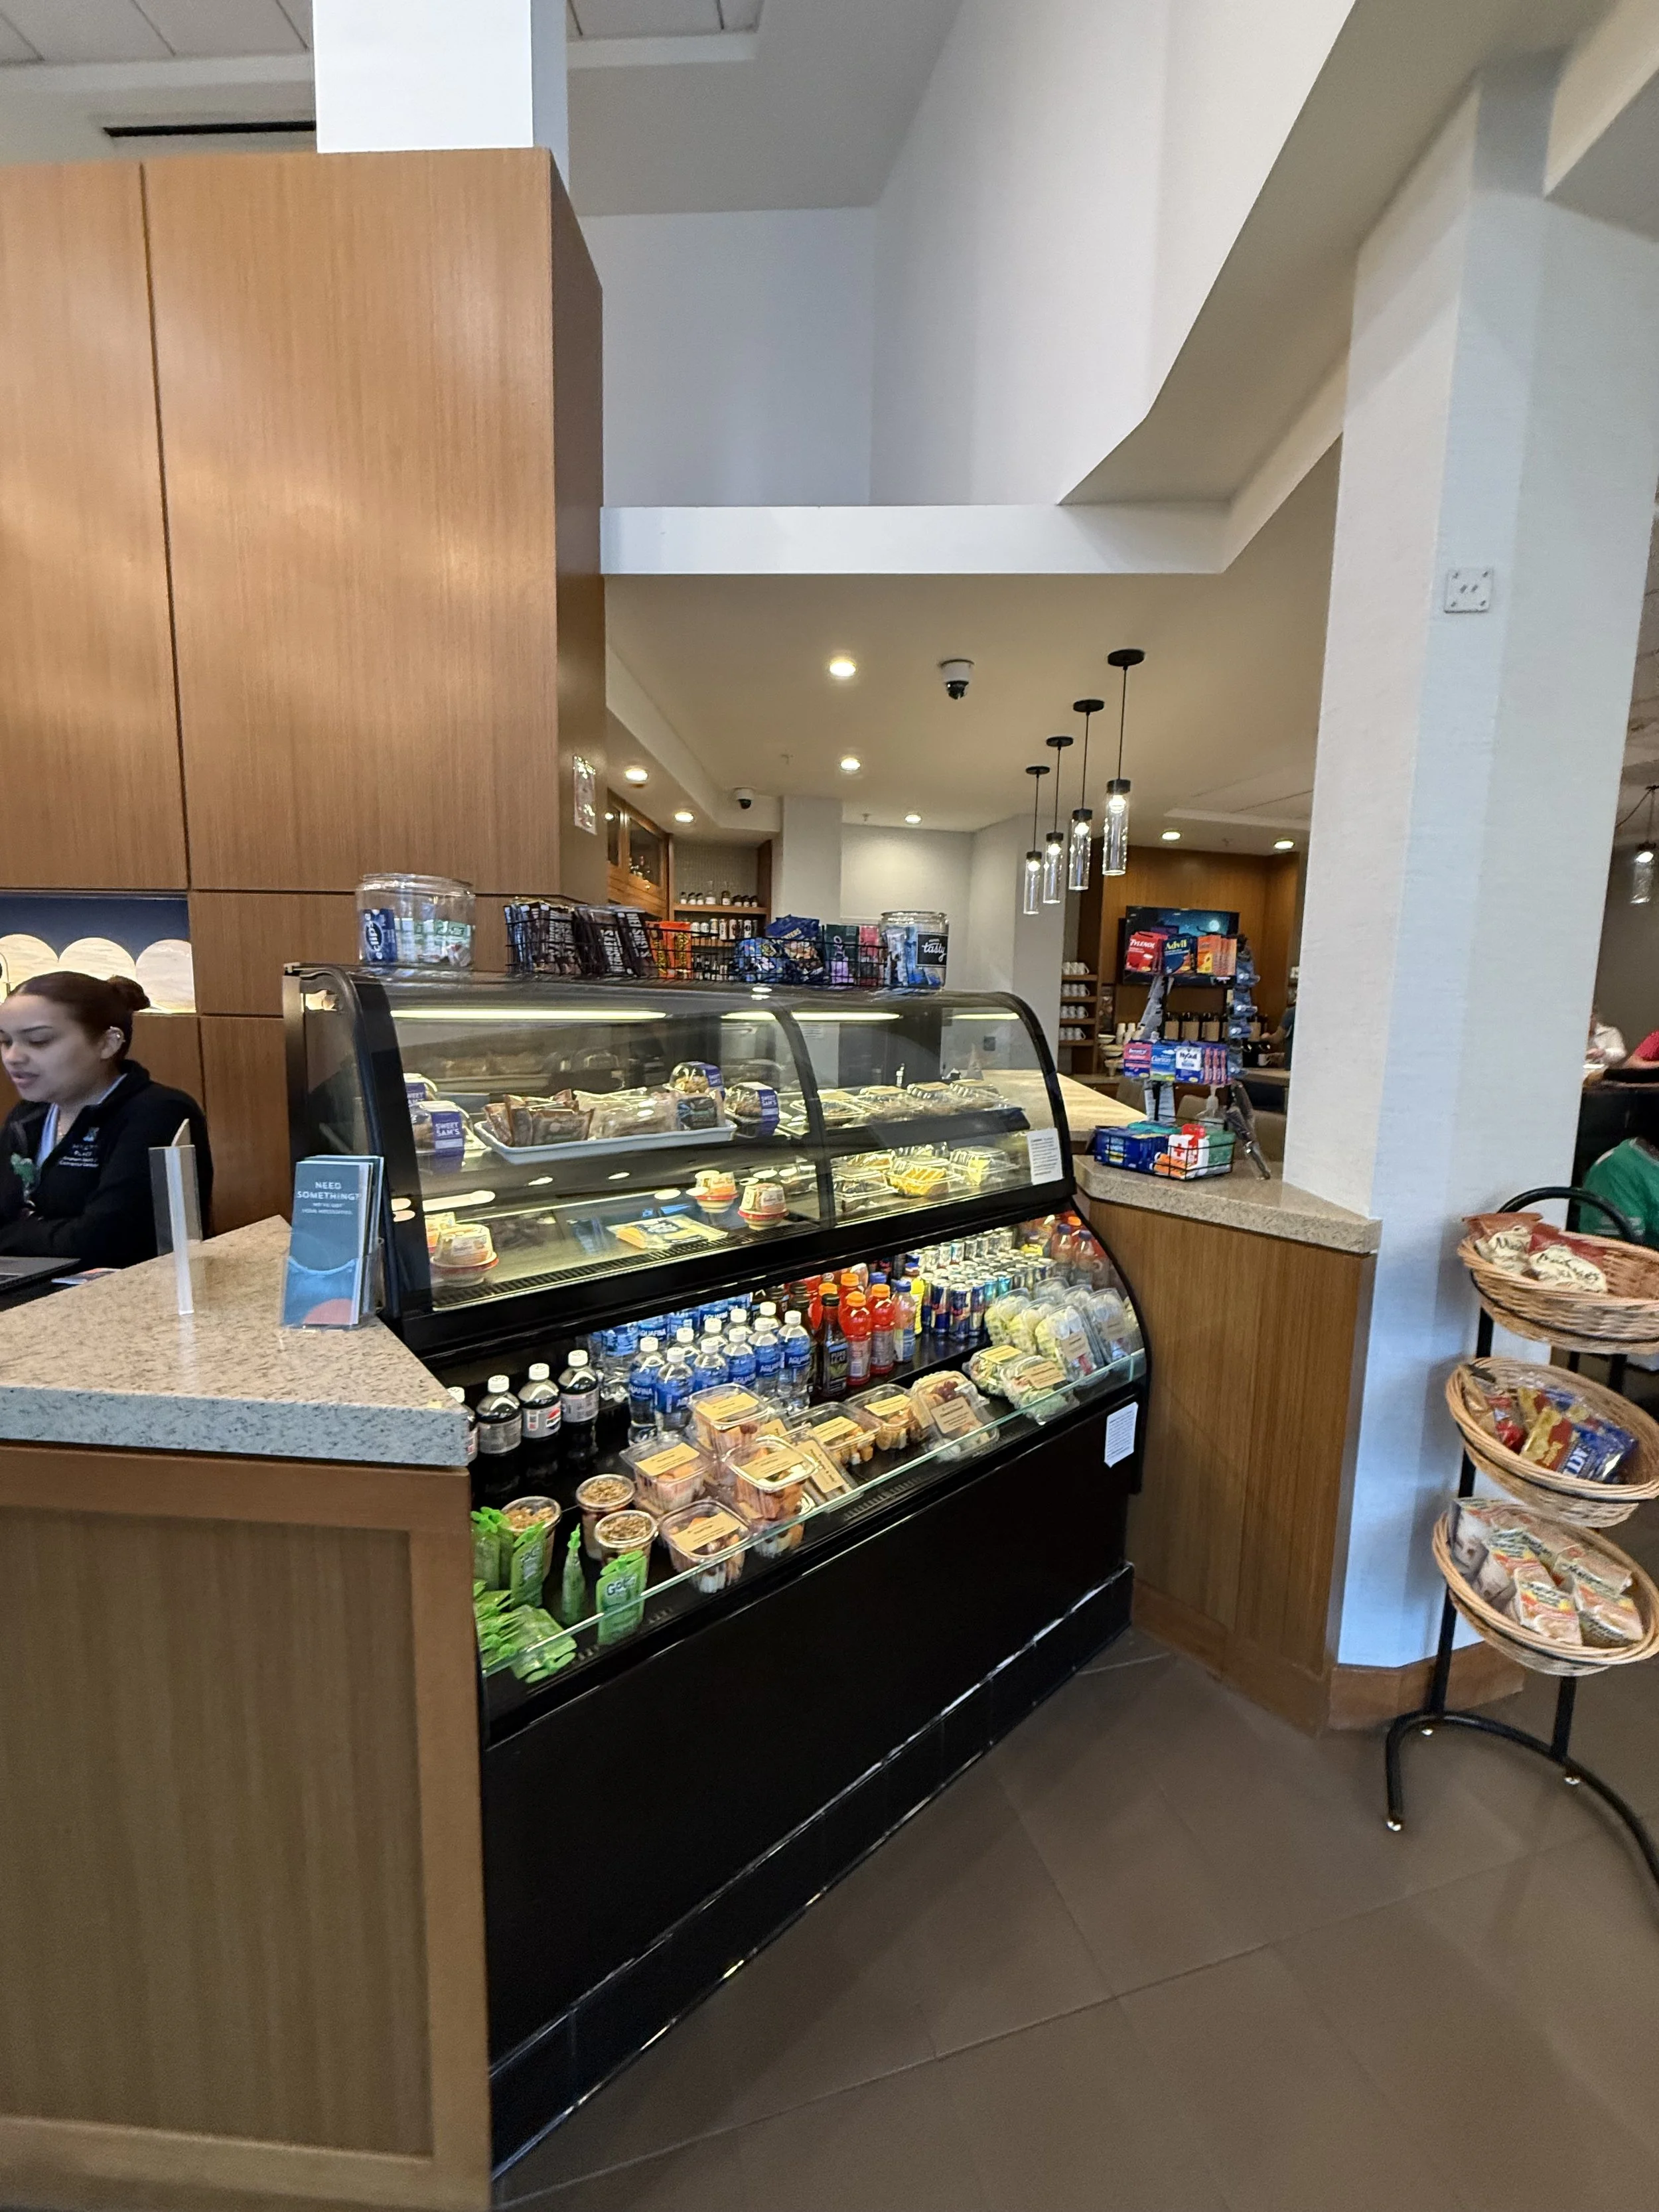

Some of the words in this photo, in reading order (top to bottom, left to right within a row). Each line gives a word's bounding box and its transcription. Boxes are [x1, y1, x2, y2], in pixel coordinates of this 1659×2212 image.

[1129, 939, 1155, 949] TYLENOL
[1166, 939, 1187, 950] Advil
[922, 941, 946, 962] tasty
[315, 1181, 342, 1190] NEED
